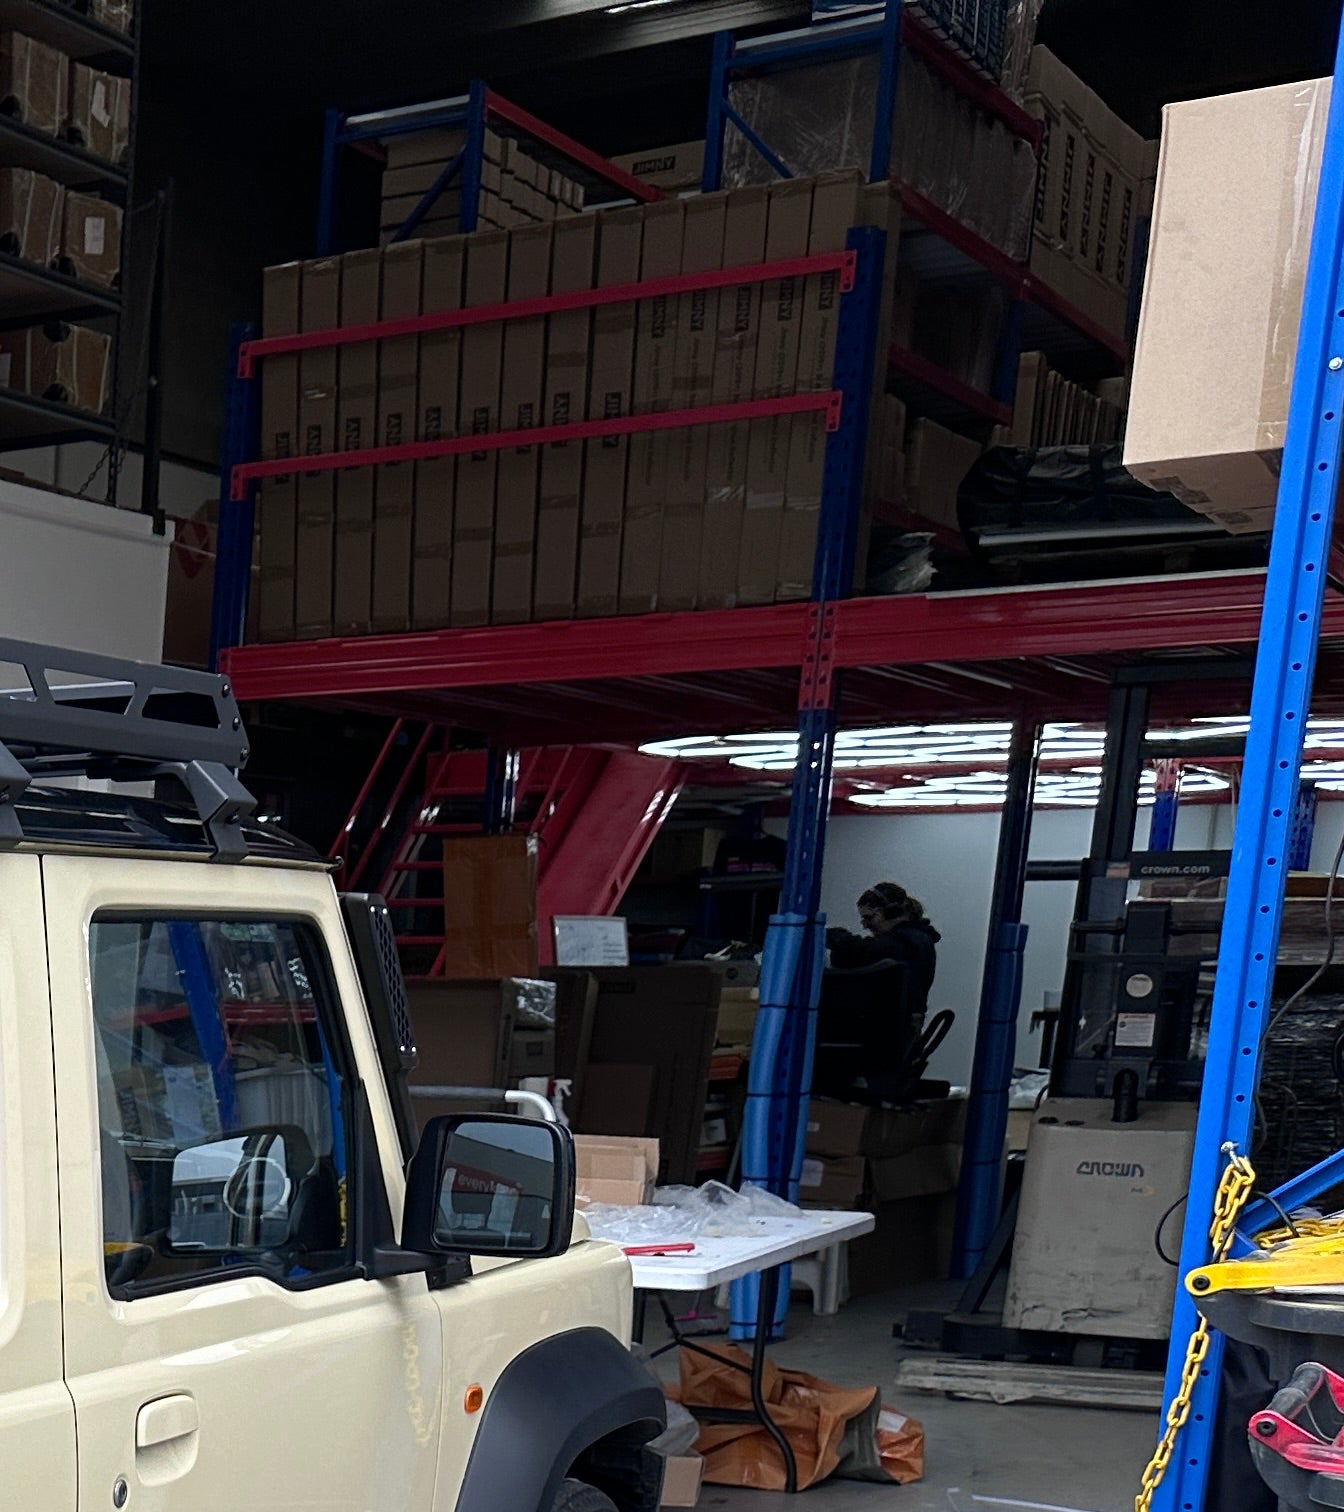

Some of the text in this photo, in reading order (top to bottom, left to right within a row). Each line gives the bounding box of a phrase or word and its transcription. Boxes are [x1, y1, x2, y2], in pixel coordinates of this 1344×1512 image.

[632, 156, 675, 176] JIMNY
[736, 287, 752, 331] JIMNY
[1140, 863, 1211, 875] crown.com
